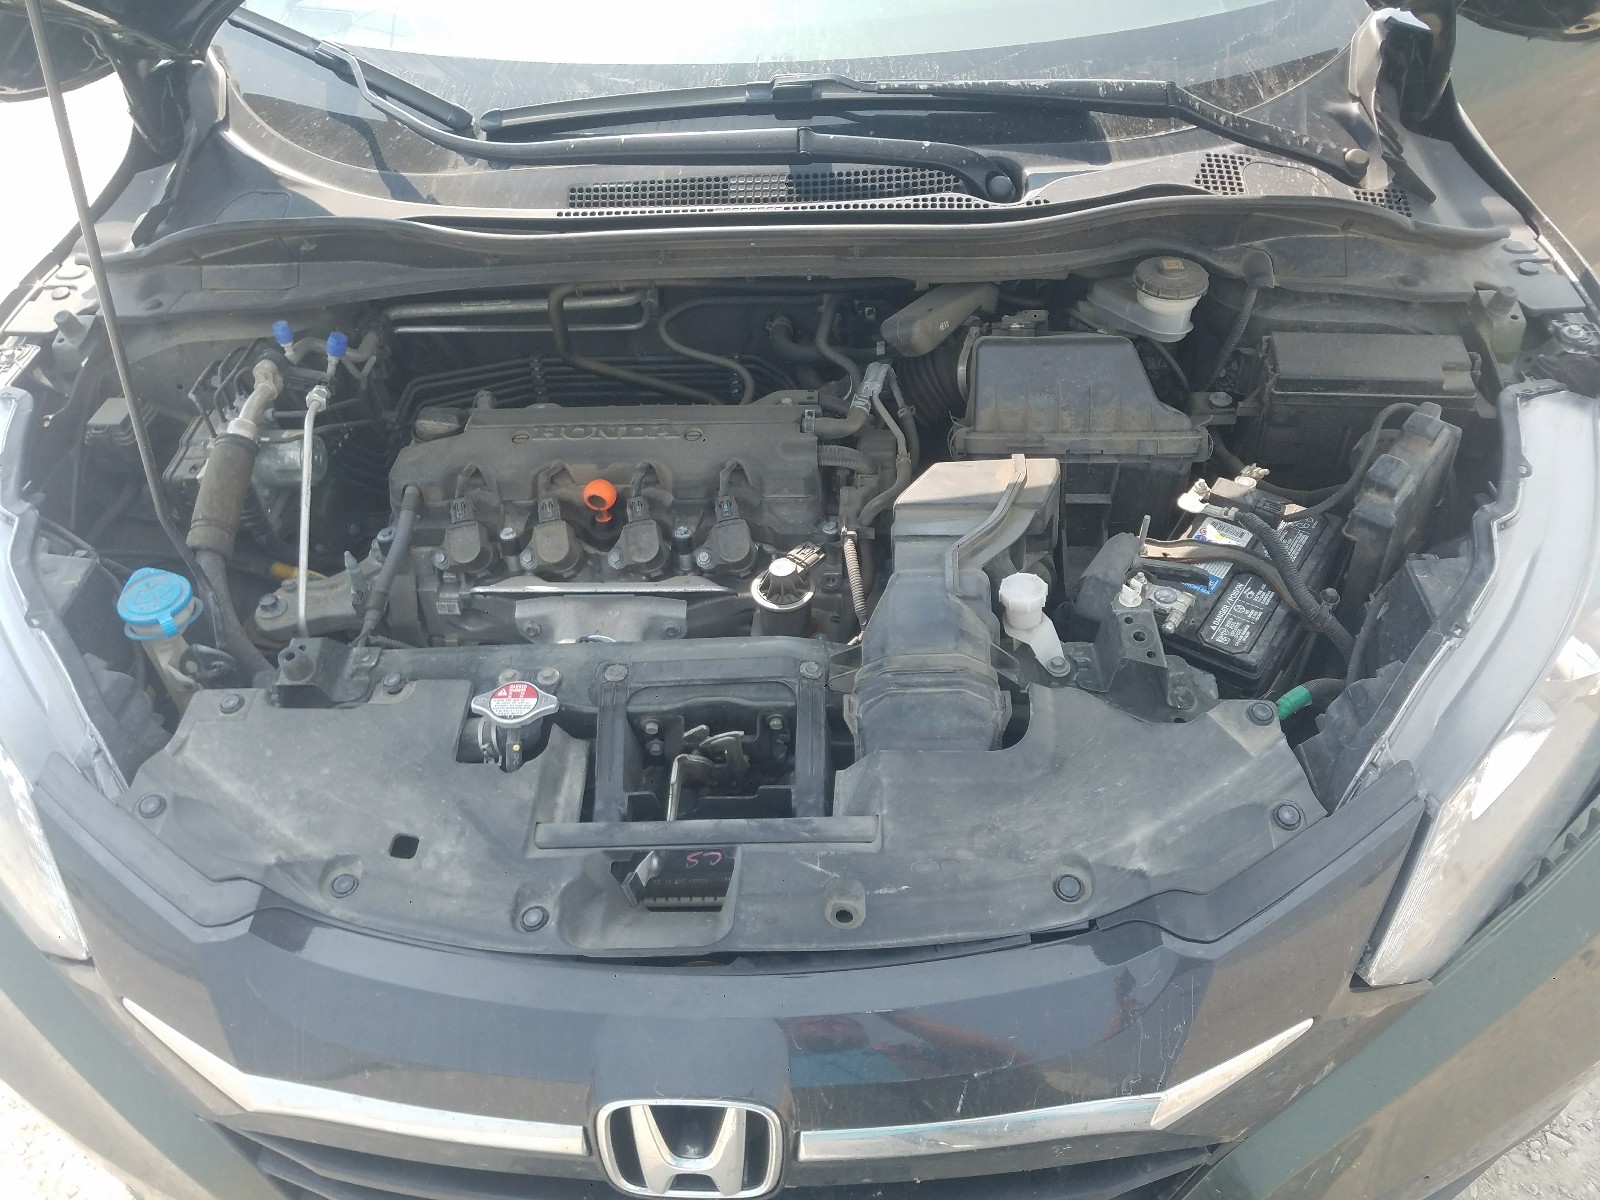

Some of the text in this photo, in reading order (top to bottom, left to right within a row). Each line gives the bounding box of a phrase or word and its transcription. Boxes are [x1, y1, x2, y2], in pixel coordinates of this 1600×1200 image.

[531, 426, 681, 441] HONDA
[1212, 604, 1231, 626] DANGER
[1227, 582, 1245, 602] POISON
